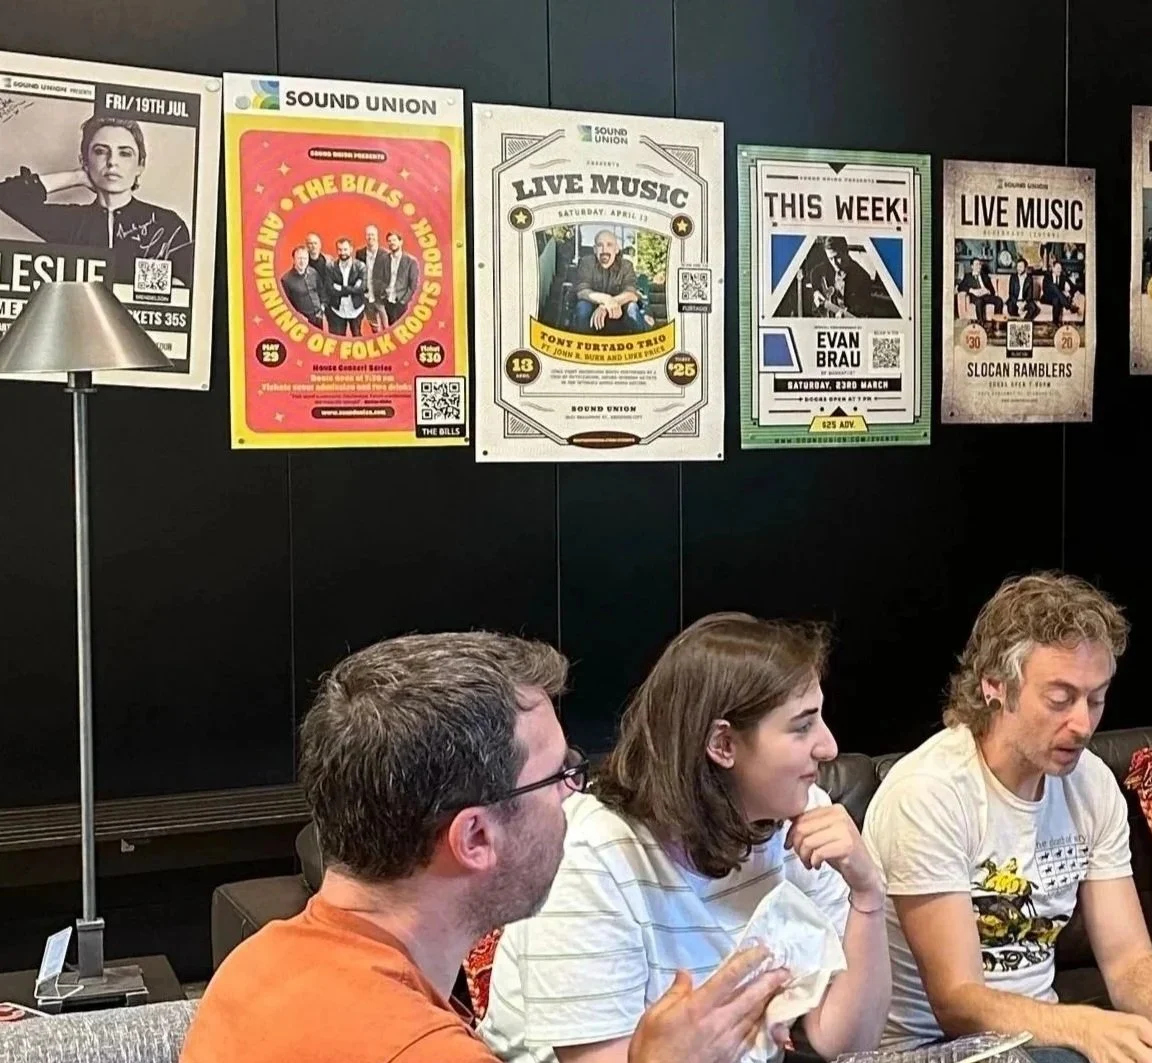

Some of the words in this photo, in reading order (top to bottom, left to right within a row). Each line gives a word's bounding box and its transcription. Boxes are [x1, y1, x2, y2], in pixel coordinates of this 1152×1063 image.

[13, 81, 39, 90] SOUND
[41, 84, 68, 93] UNION
[105, 93, 165, 115] FRI/19TH
[167, 101, 189, 117] JUL
[286, 91, 359, 109] SOUND
[366, 96, 437, 115] UNION
[594, 126, 627, 136] SOUND
[594, 135, 628, 145] UNION
[293, 174, 338, 204] THE
[341, 174, 403, 208] BILLS
[512, 174, 583, 201] LIVE
[590, 173, 689, 209] MUSIC
[610, 210, 636, 219] APRIL
[764, 192, 822, 219] THIS
[835, 195, 908, 223] WEEK!
[961, 194, 1009, 227] LIVE
[1016, 197, 1083, 230] MUSIC
[257, 211, 284, 246] AN
[410, 217, 443, 277] ROCK
[254, 247, 309, 342] EVENING
[128, 309, 161, 325] KETS
[393, 279, 442, 344] ROOTS
[307, 333, 339, 356] OF
[340, 333, 396, 360] FOLK
[540, 332, 574, 348] TONY
[577, 341, 634, 352] FURTADO
[636, 333, 667, 348] TRIO
[817, 331, 860, 349] EVAN
[966, 336, 981, 349] $30
[1061, 337, 1072, 349] 20
[419, 352, 442, 363] $30
[512, 358, 534, 372] 13
[816, 350, 861, 368] BRAU
[668, 362, 696, 377] $25
[967, 362, 1010, 378] SLOCAN
[1013, 362, 1073, 378] RAMBLERS
[860, 381, 889, 389] MARCH
[422, 427, 438, 436] THE
[439, 427, 460, 436] BILLS
